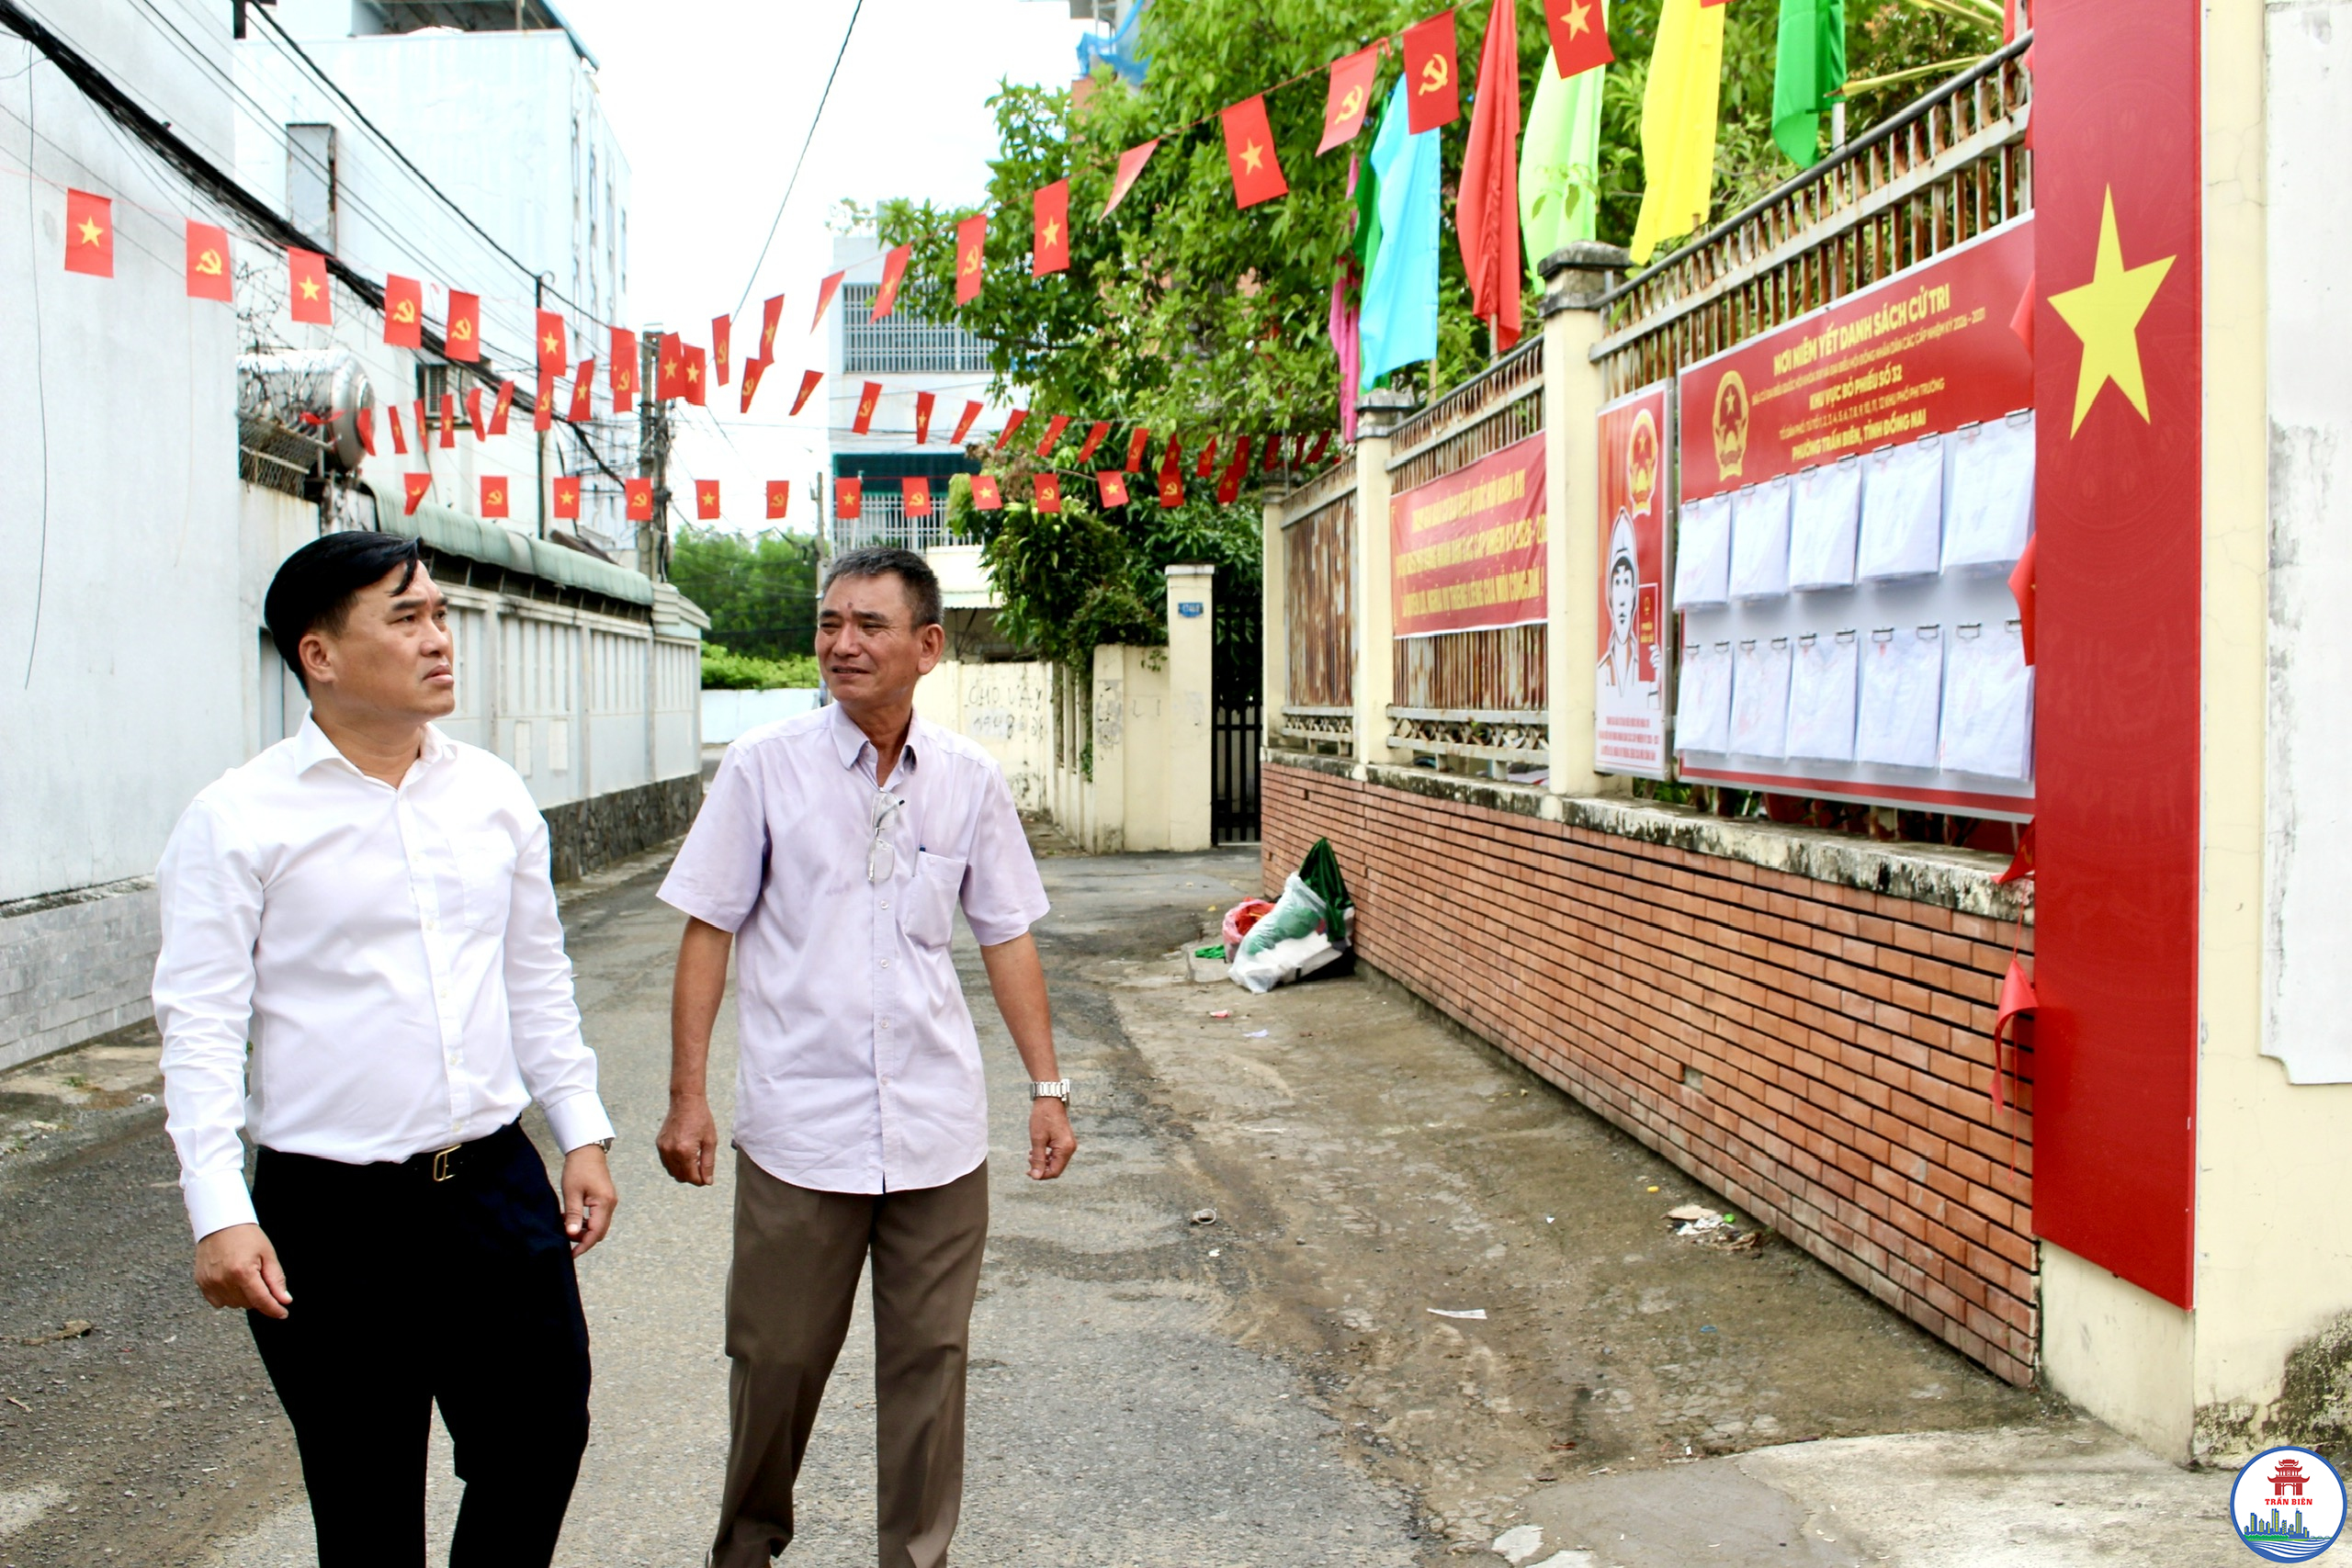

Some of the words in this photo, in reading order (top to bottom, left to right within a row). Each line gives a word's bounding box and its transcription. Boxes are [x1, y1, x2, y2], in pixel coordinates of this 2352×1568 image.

[1819, 322, 1838, 358] YẾT
[1840, 314, 1872, 351] DANH
[1874, 302, 1906, 337] SÁCH
[1908, 285, 1928, 322] CỬ
[1928, 283, 1950, 315] TRI
[1842, 376, 1854, 400] BỎ
[1854, 367, 1878, 395] PHIẾU
[1879, 361, 1891, 388] SỐ
[1910, 408, 1927, 429] NAI
